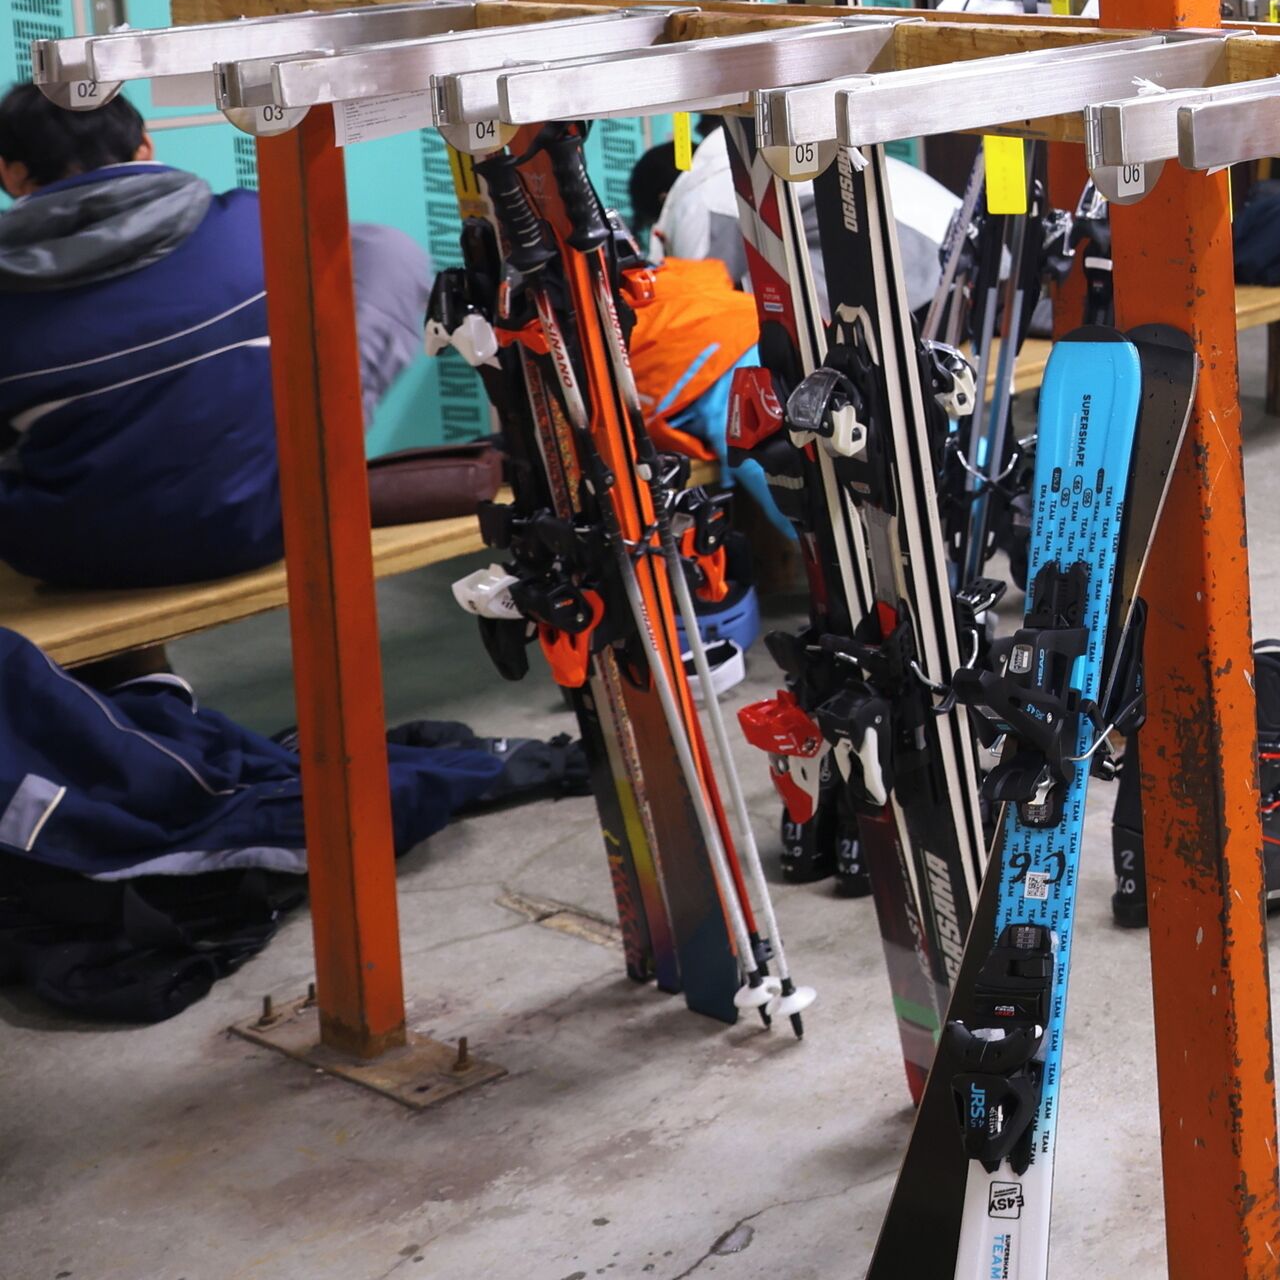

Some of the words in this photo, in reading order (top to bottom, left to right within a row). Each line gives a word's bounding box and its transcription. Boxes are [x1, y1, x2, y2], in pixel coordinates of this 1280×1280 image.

[78, 82, 97, 98] 02
[263, 105, 284, 122] 03
[476, 121, 495, 139] 04
[795, 144, 814, 163] 05
[1122, 164, 1140, 184] 06
[546, 318, 575, 390] SINANO
[1075, 394, 1092, 467] SUPERSHAPE
[1105, 486, 1113, 507] TEAM
[1049, 500, 1057, 521] TEAM
[1071, 501, 1079, 521] TEAM
[1092, 501, 1100, 521] TEAM
[1036, 516, 1044, 537] TEAM
[1057, 517, 1066, 538] TEAM
[1080, 518, 1088, 538] TEAM
[1101, 518, 1109, 538] TEAM
[1045, 531, 1053, 551] TEAM
[1067, 531, 1075, 552] TEAM
[1089, 532, 1097, 552] TEAM
[1032, 546, 1040, 567] TEAM
[1098, 548, 1106, 569] TEAM
[1095, 579, 1103, 600] TEAM
[1091, 611, 1099, 631] TEAM
[1088, 642, 1096, 662] TEAM
[1036, 648, 1045, 686] HEAD
[1085, 673, 1094, 694] TEAM
[1075, 768, 1083, 789] TEAM
[1072, 800, 1080, 821] TEAM
[1120, 850, 1135, 870] 2
[1066, 864, 1074, 886] TEAM
[1017, 895, 1025, 917] TEAM
[1063, 897, 1071, 919] TEAM
[1054, 996, 1062, 1018] TEAM
[1050, 1029, 1059, 1051] TEAM
[1047, 1063, 1056, 1085] TEAM
[970, 1082, 986, 1114] JRS
[1044, 1096, 1053, 1119] TEAM
[1042, 1130, 1050, 1153] TEAM
[1029, 1142, 1037, 1165] TEAM
[989, 1234, 1005, 1280] TEAM
[1002, 1234, 1012, 1279] SUPERSHAPE
